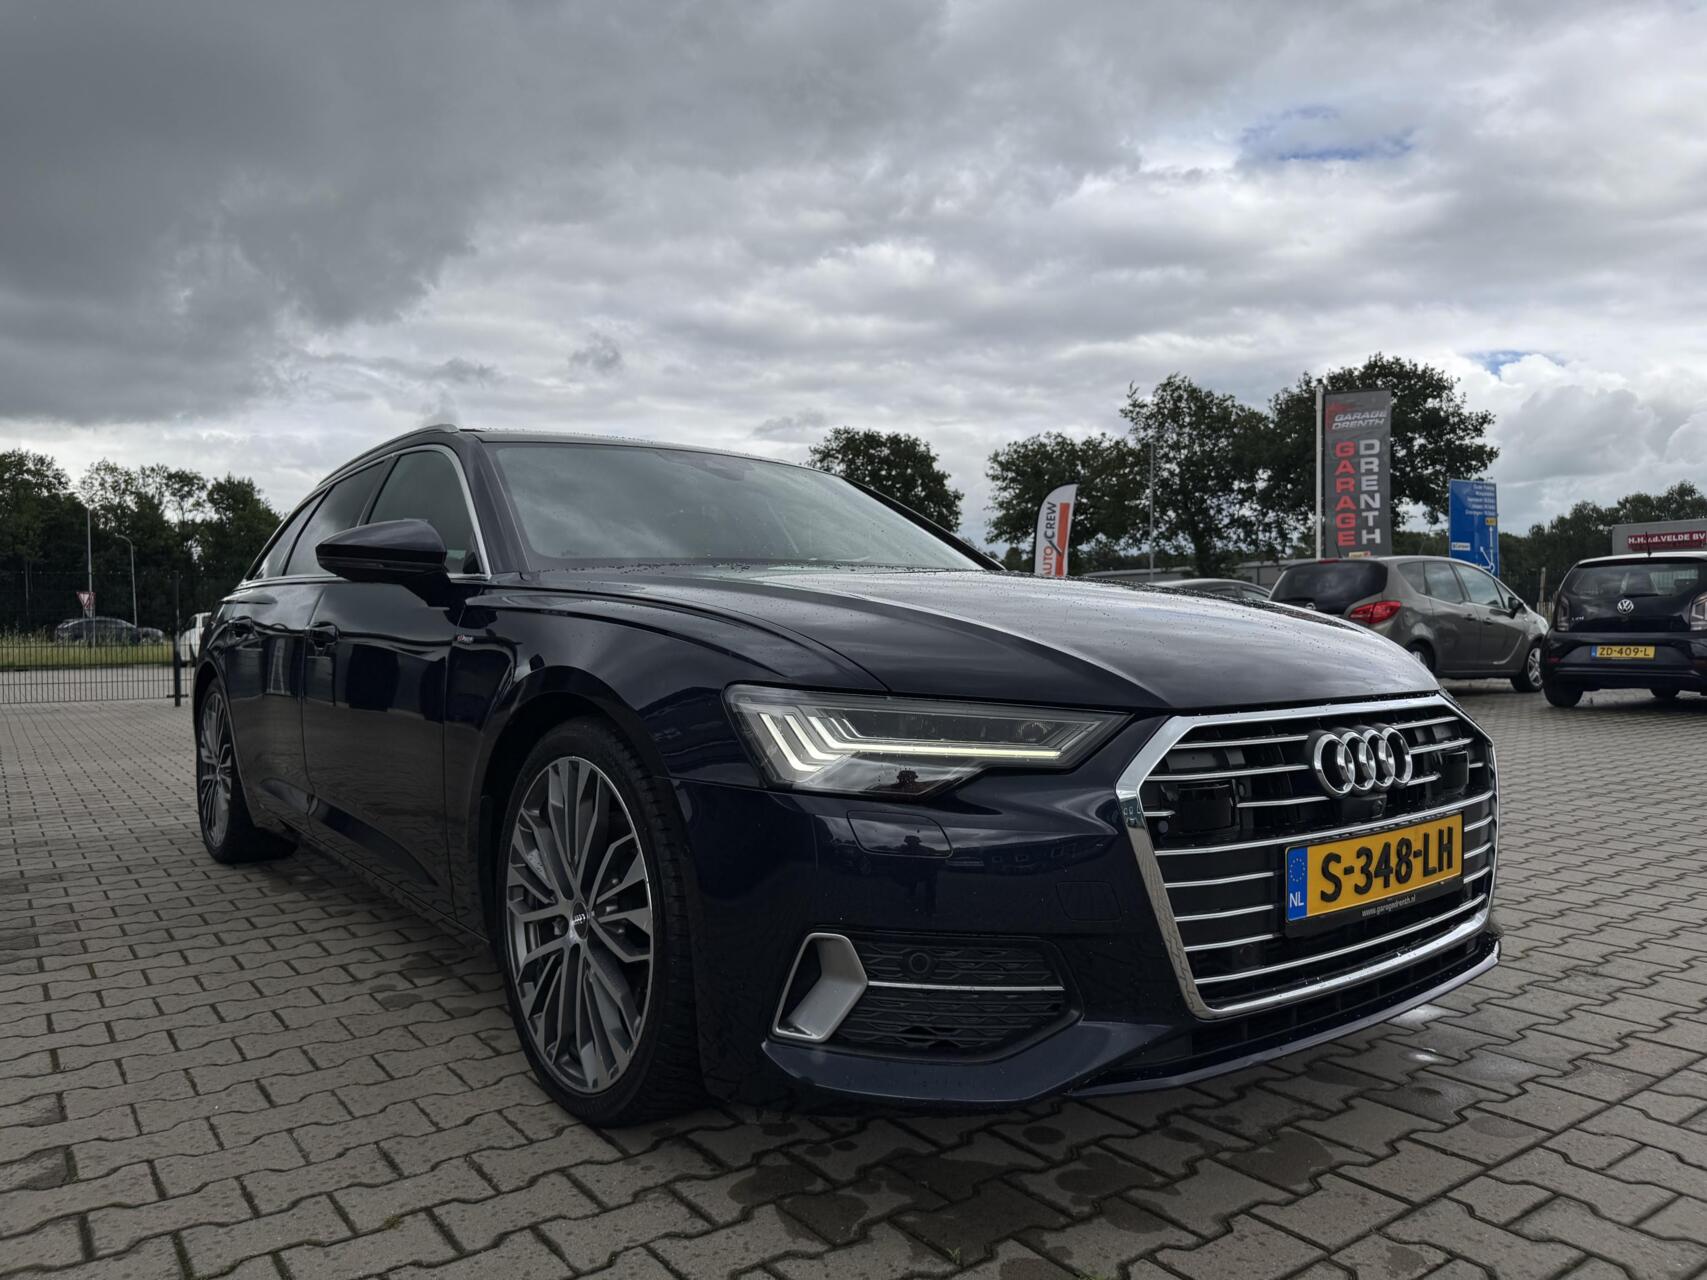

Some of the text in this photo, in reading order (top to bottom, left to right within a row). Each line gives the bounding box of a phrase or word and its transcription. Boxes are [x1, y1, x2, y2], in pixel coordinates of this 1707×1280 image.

[1334, 411, 1387, 421] GARAGE
[1331, 418, 1385, 431] DRENTH
[1335, 441, 1357, 546] GARAGE
[1359, 439, 1381, 545] DRENTH
[1692, 532, 1706, 541] BV
[1599, 646, 1650, 656] ZD-409-L
[1320, 826, 1453, 903] S-348-LH
[1289, 890, 1304, 908] NL
